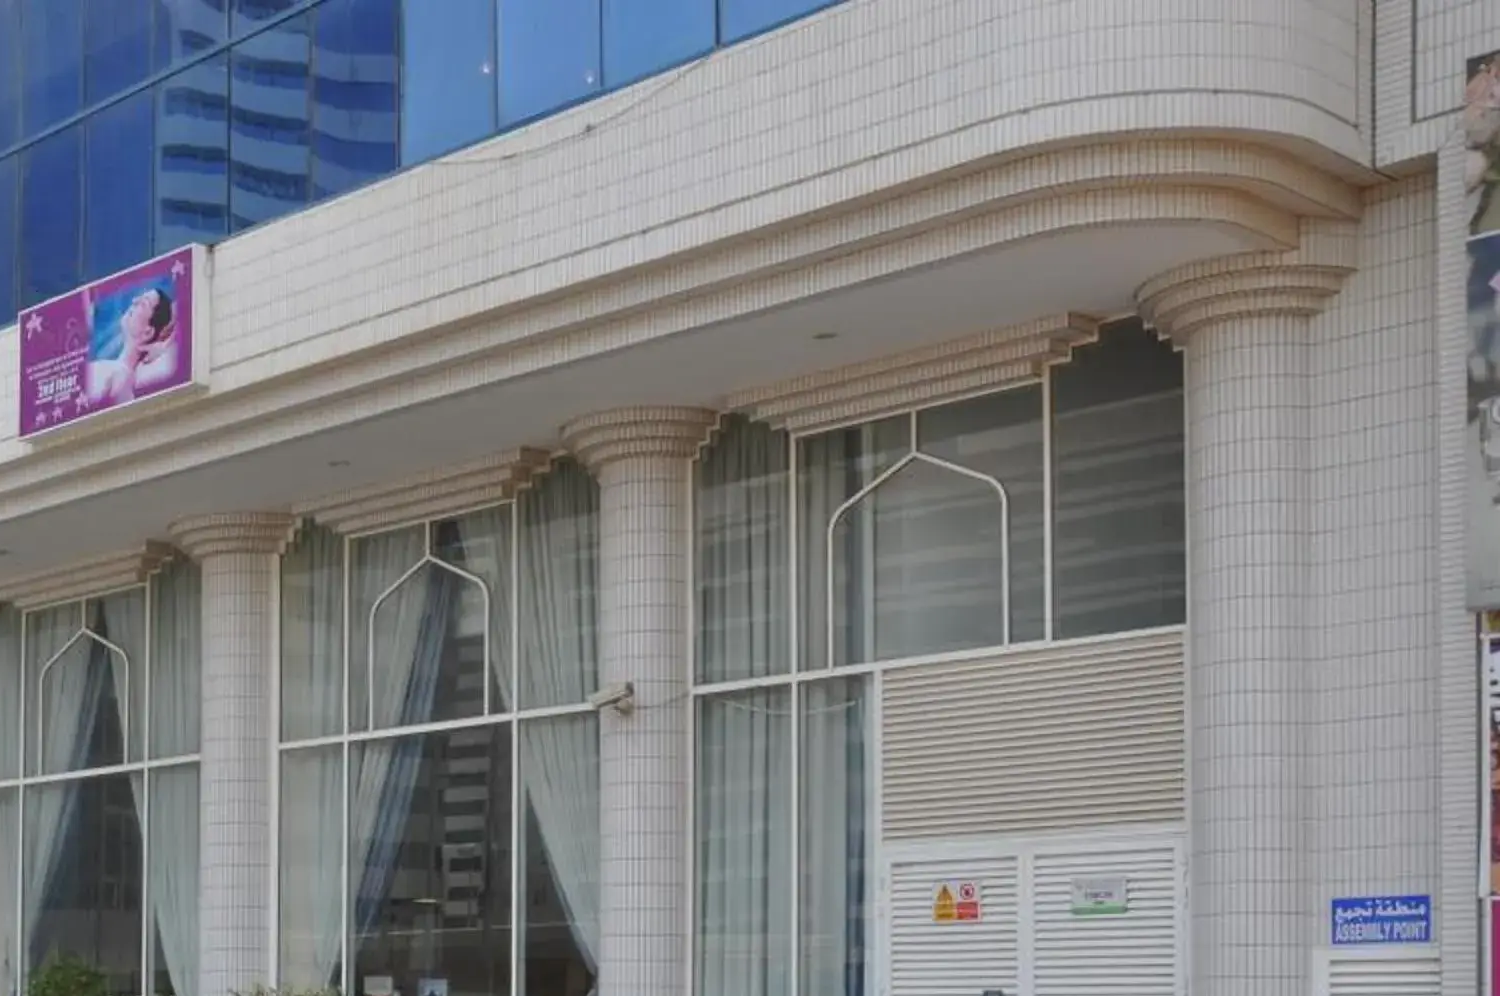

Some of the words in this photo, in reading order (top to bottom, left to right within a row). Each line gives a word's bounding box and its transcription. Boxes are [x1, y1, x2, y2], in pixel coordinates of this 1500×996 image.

[1335, 901, 1372, 923] تجمع
[1375, 899, 1427, 917] منطقة
[1393, 921, 1427, 941] POINT
